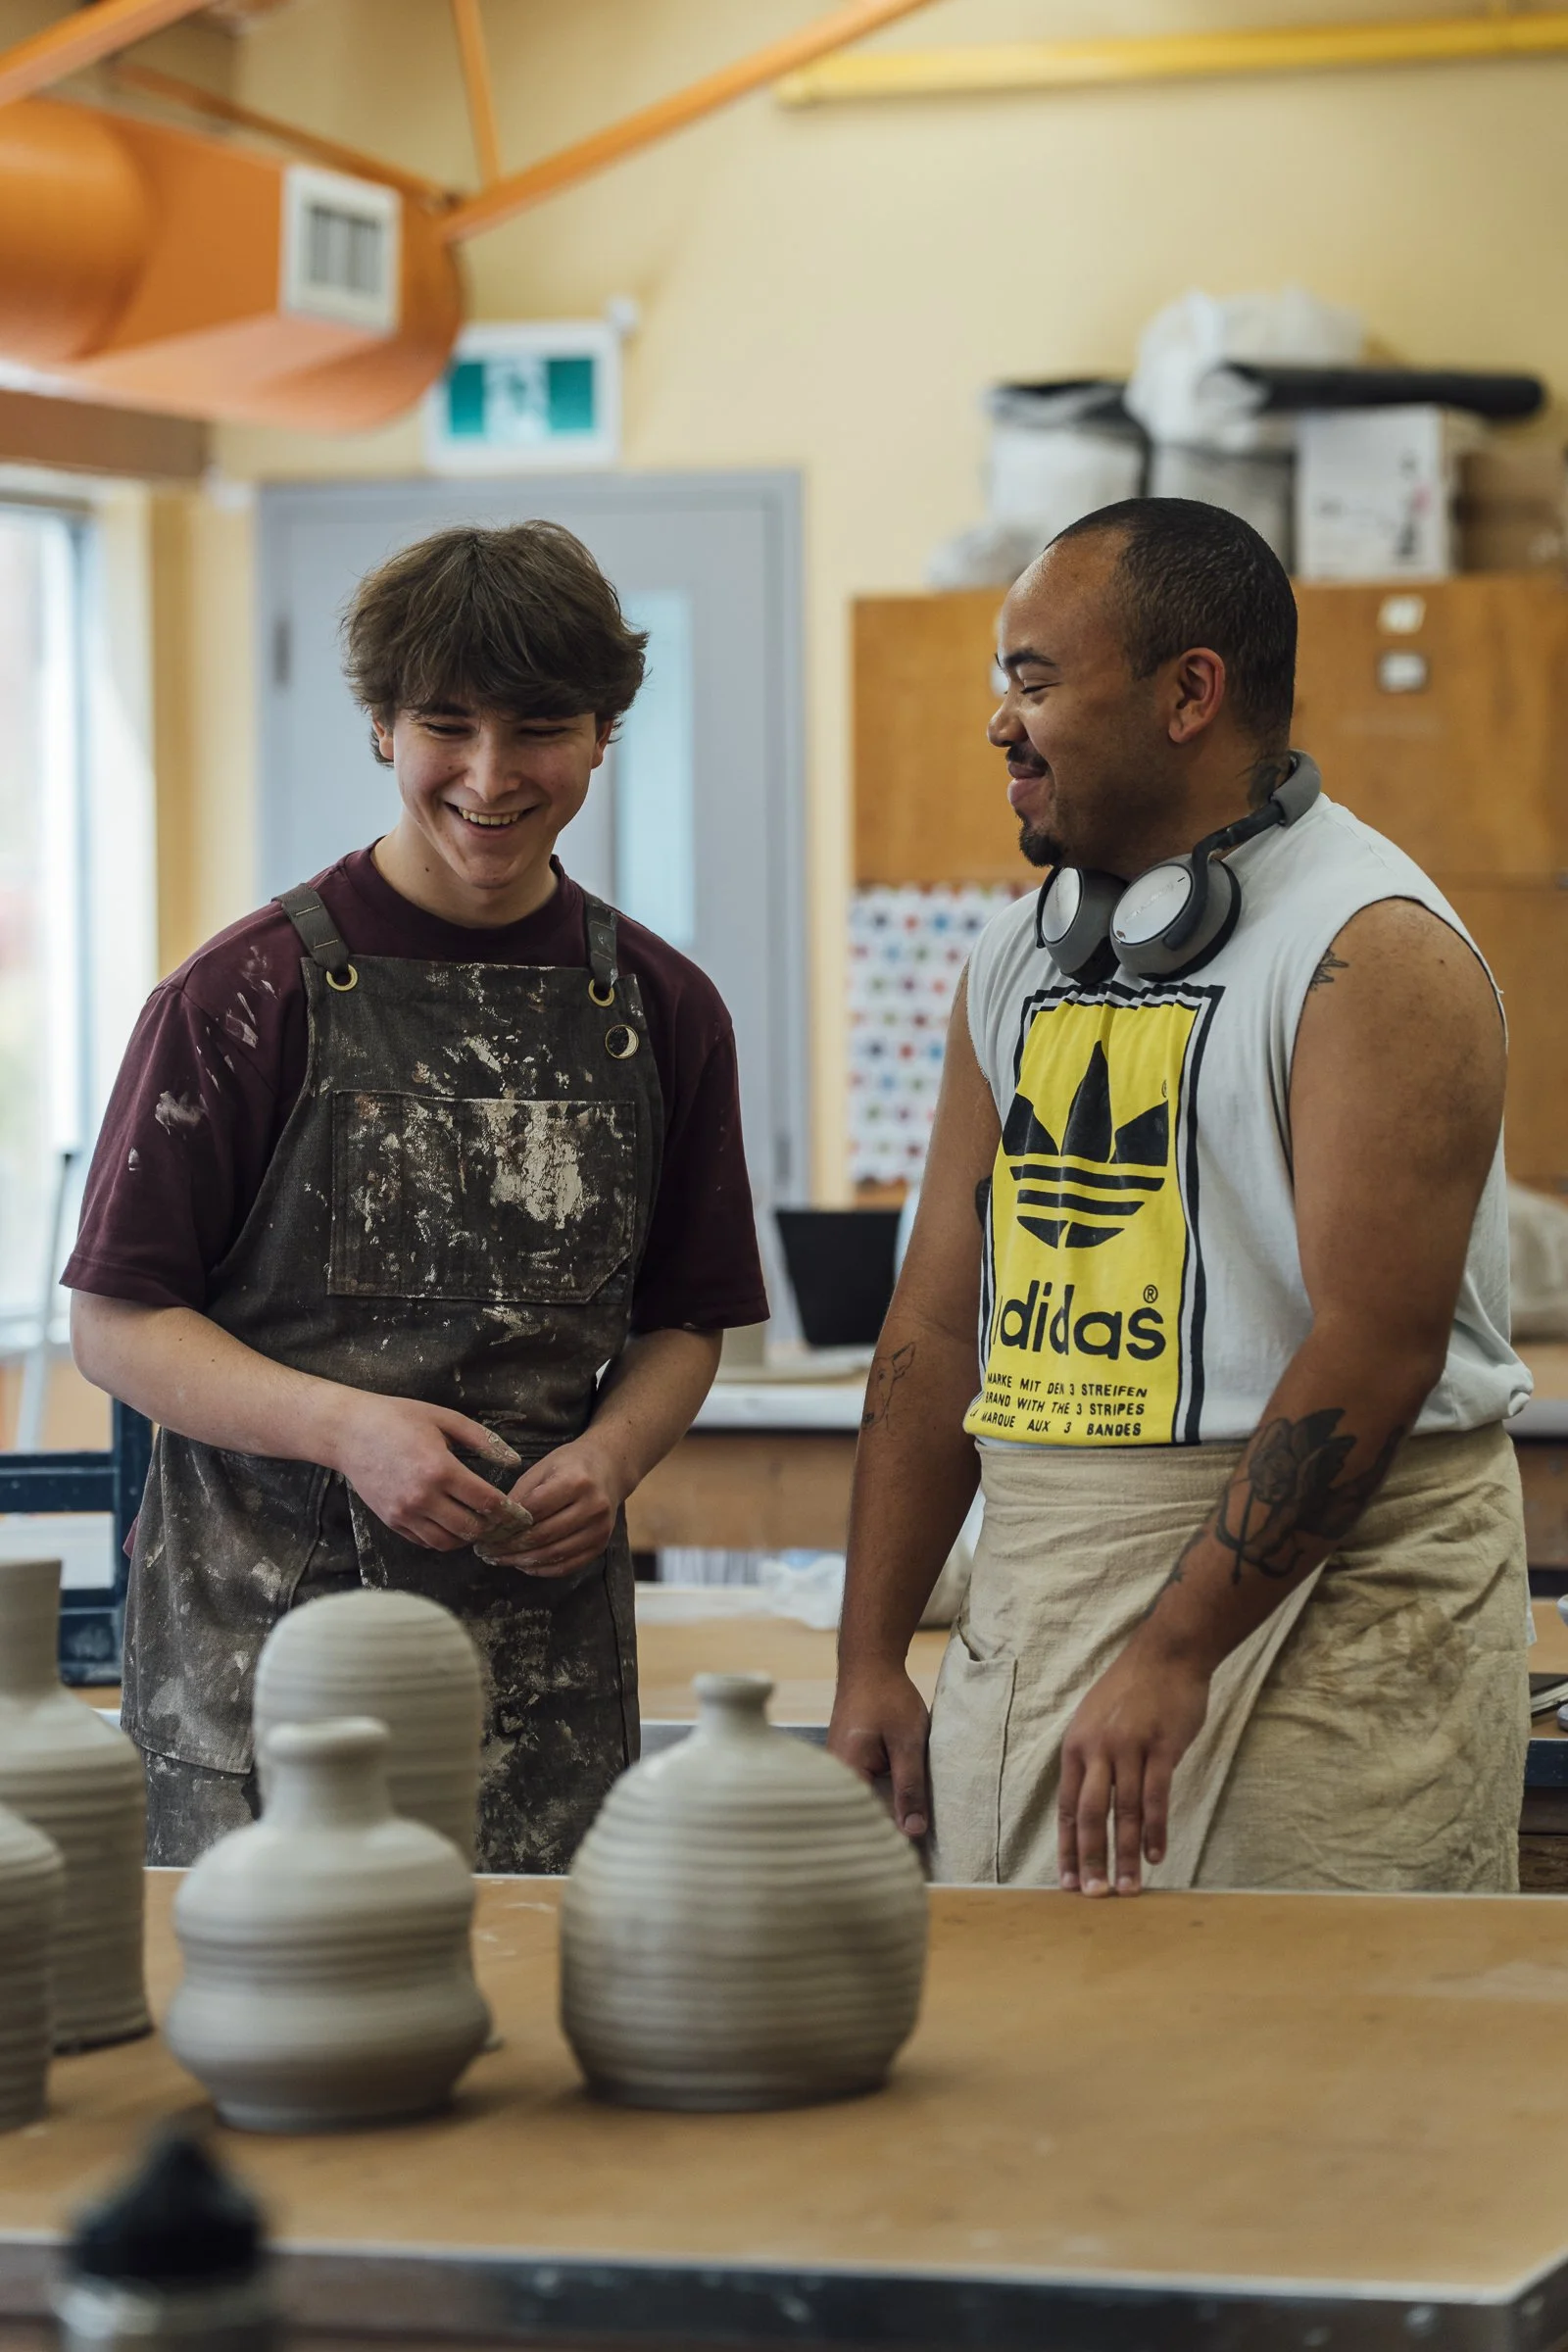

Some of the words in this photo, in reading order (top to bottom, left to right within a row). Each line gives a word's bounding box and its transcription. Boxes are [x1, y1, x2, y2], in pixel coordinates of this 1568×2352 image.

[993, 1280, 1166, 1360] didas
[1019, 1377, 1042, 1393] MIT
[1069, 1383, 1075, 1396] 3
[1081, 1383, 1148, 1397] STREIFEN
[1017, 1396, 1046, 1413] WITH
[1051, 1401, 1070, 1414] THE
[1076, 1402, 1083, 1415] 3
[1090, 1402, 1145, 1415] STRIPES
[981, 1411, 1016, 1428] MARQUE
[1026, 1418, 1052, 1433] AUX
[1063, 1421, 1072, 1434] 3
[1086, 1422, 1142, 1437] BANDES
